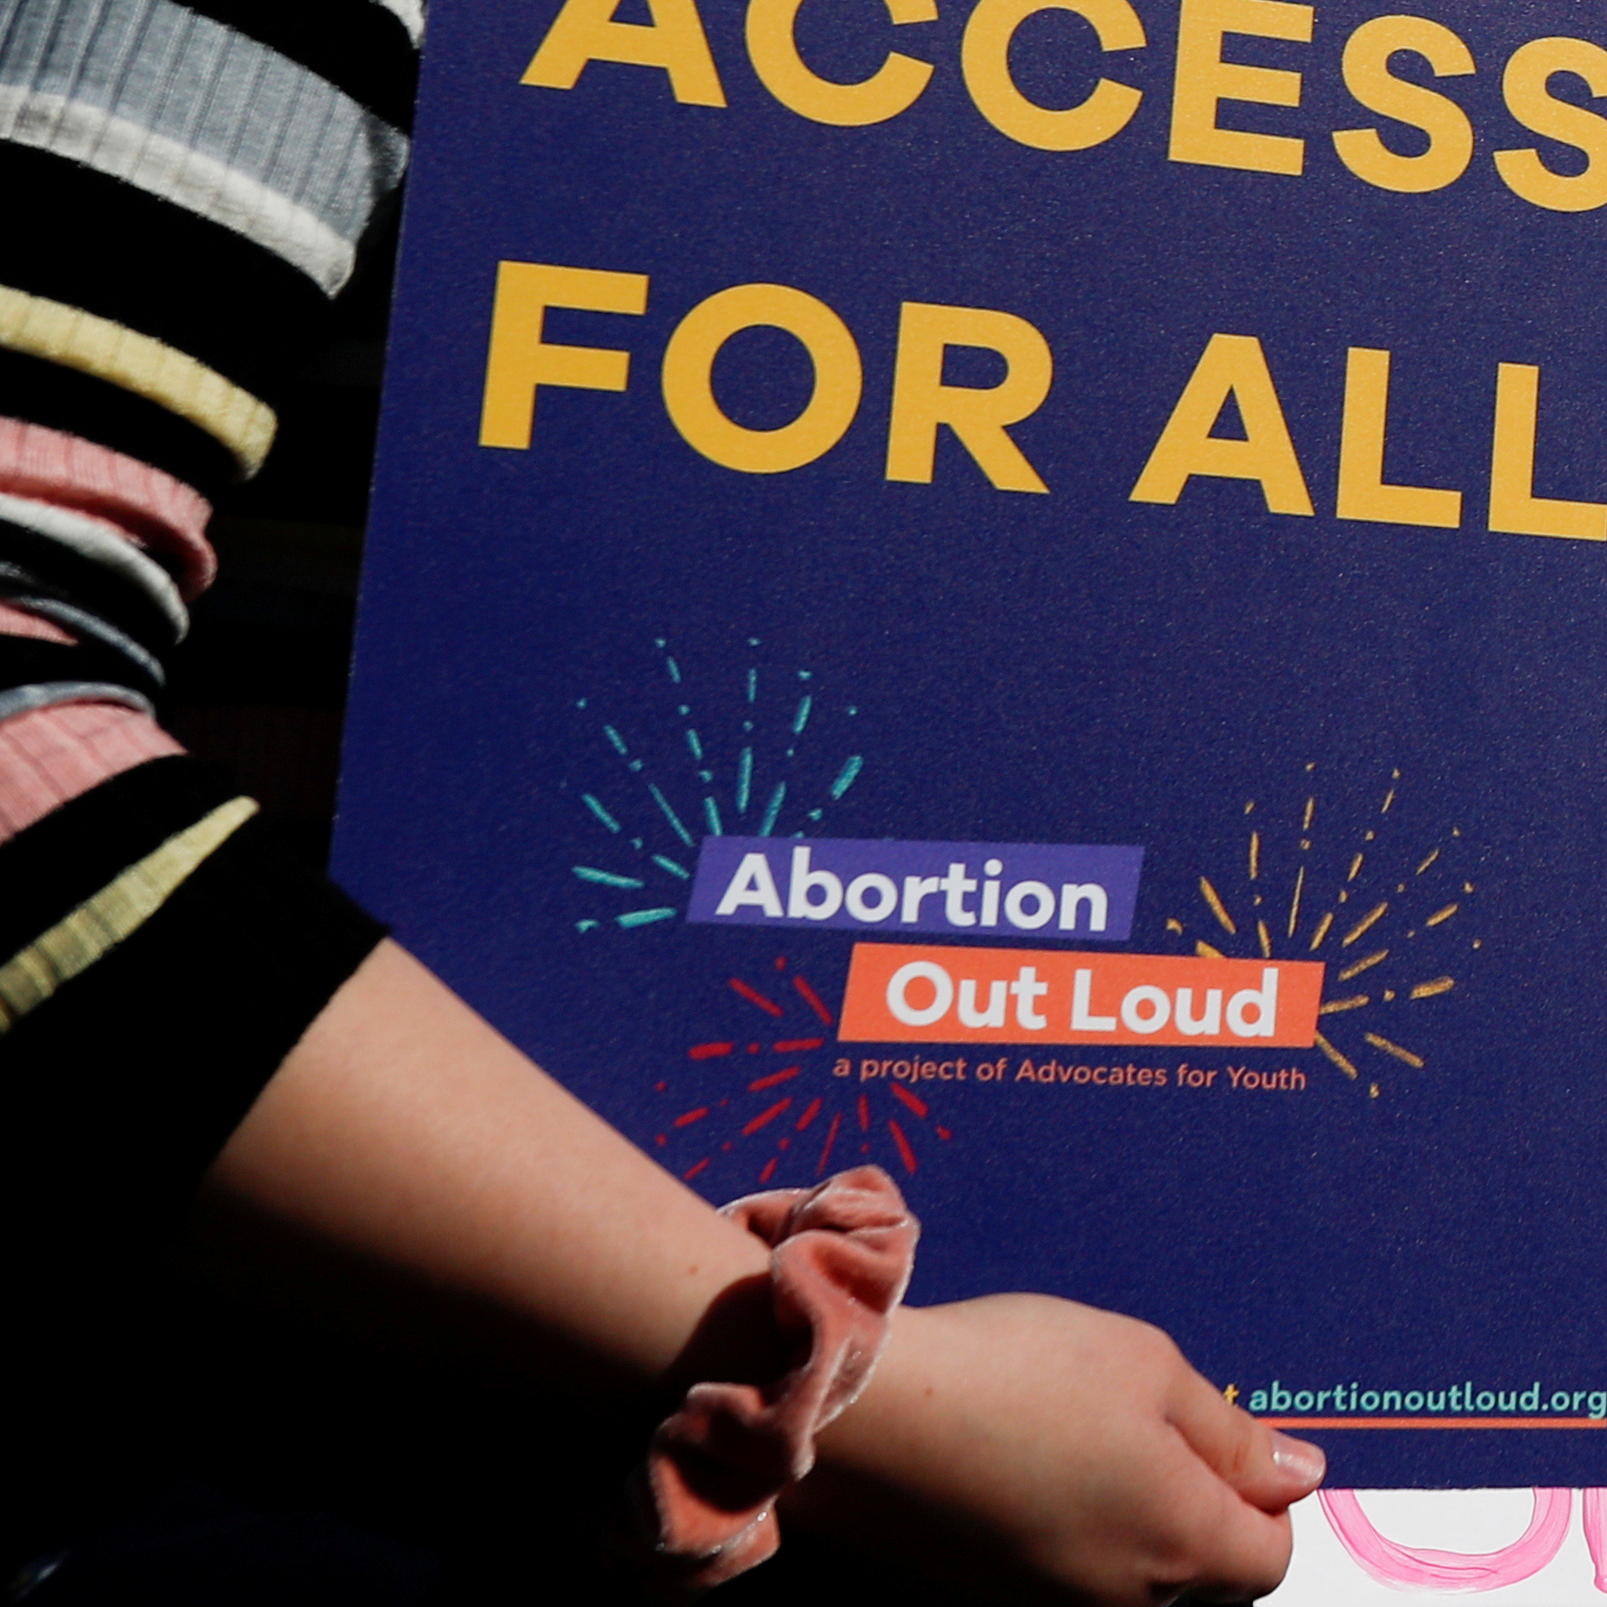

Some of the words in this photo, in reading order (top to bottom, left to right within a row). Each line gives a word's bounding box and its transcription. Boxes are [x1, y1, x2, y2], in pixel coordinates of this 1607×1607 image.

[477, 259, 1054, 494] FOR
[714, 846, 1109, 932] Abortion
[885, 960, 1050, 1031] Out
[1071, 967, 1280, 1038] Loud
[833, 1060, 851, 1078] a
[860, 1054, 970, 1083] project
[976, 1055, 1008, 1081] of
[1016, 1057, 1168, 1087] Advocates
[1177, 1060, 1221, 1089] for
[1225, 1063, 1307, 1091] Youth
